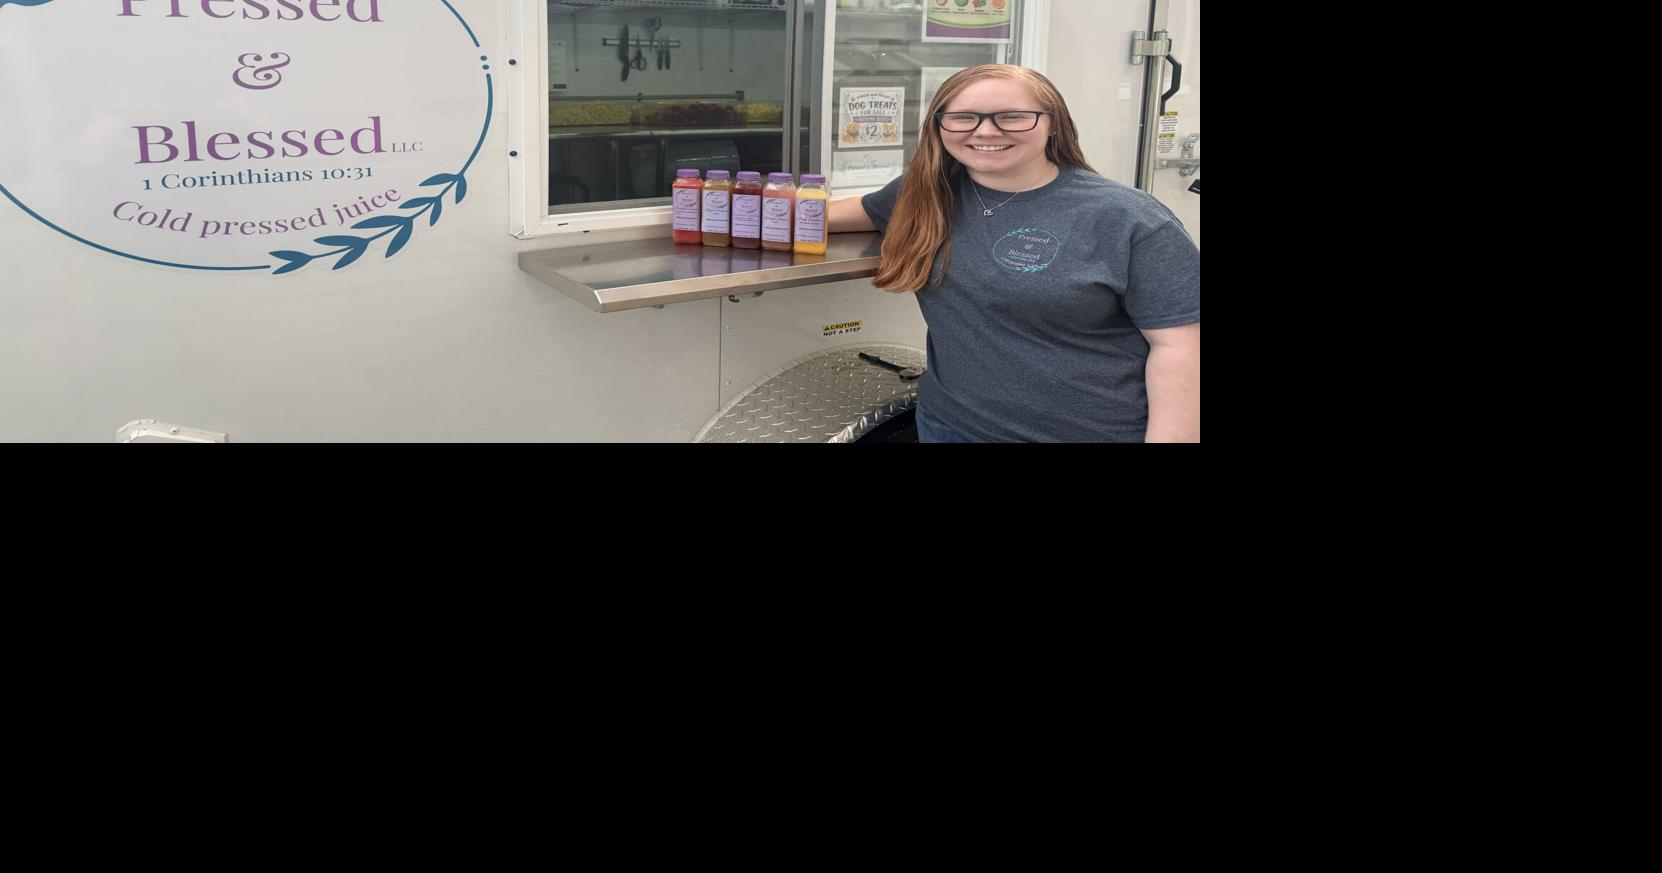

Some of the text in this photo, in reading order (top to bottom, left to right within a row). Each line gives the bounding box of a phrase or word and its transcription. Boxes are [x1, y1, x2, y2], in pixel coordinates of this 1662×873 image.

[232, 52, 291, 90] &
[848, 101, 897, 111] DOG TREATS
[130, 115, 424, 165] Blessed LLC
[865, 125, 878, 137] $2
[143, 167, 373, 191] 1 Corinthians 10:31
[112, 188, 401, 239] Cold pressed juice
[830, 321, 859, 330] CAUTION
